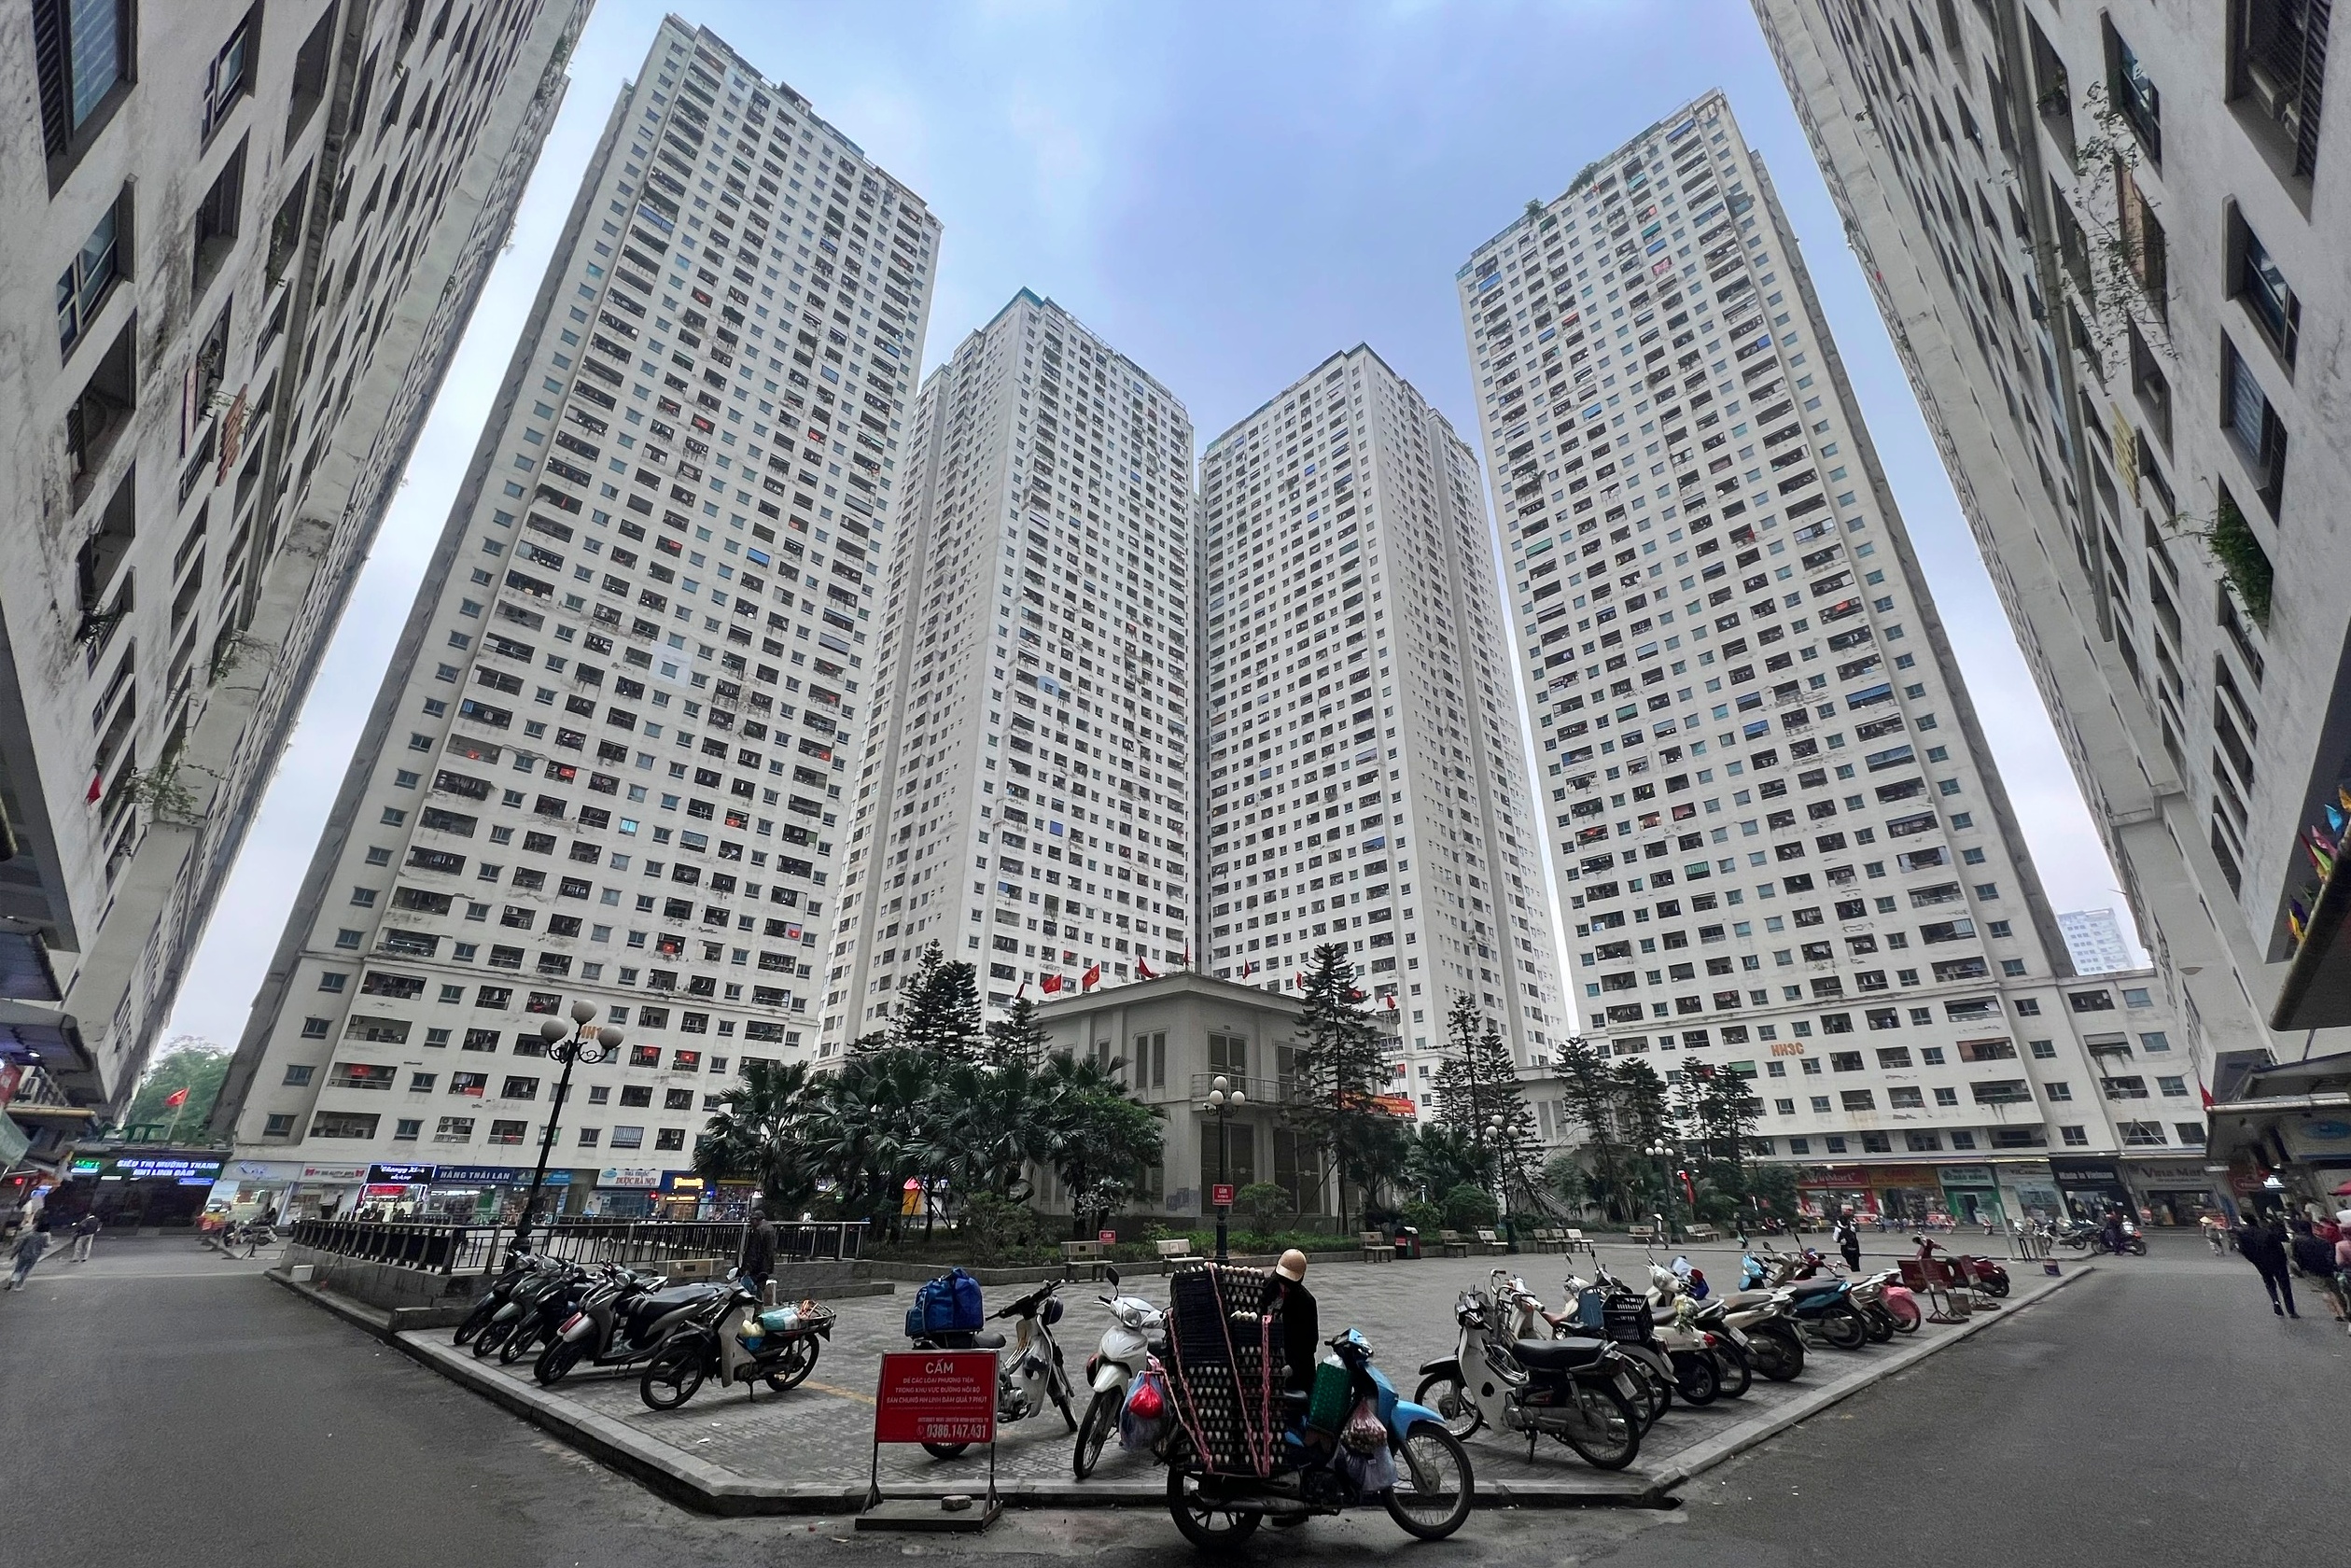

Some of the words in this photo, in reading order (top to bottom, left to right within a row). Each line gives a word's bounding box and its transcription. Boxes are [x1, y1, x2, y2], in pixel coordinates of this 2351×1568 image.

[1770, 1042, 1804, 1057] HH3C
[440, 1170, 466, 1179] HÀNG
[469, 1170, 490, 1179] THÁI
[616, 1176, 635, 1186] DƯỢC
[635, 1176, 644, 1184] HÀ
[645, 1177, 656, 1186] NỘI
[926, 1359, 954, 1374] CẤM
[927, 1424, 987, 1438] 0386.147.431
